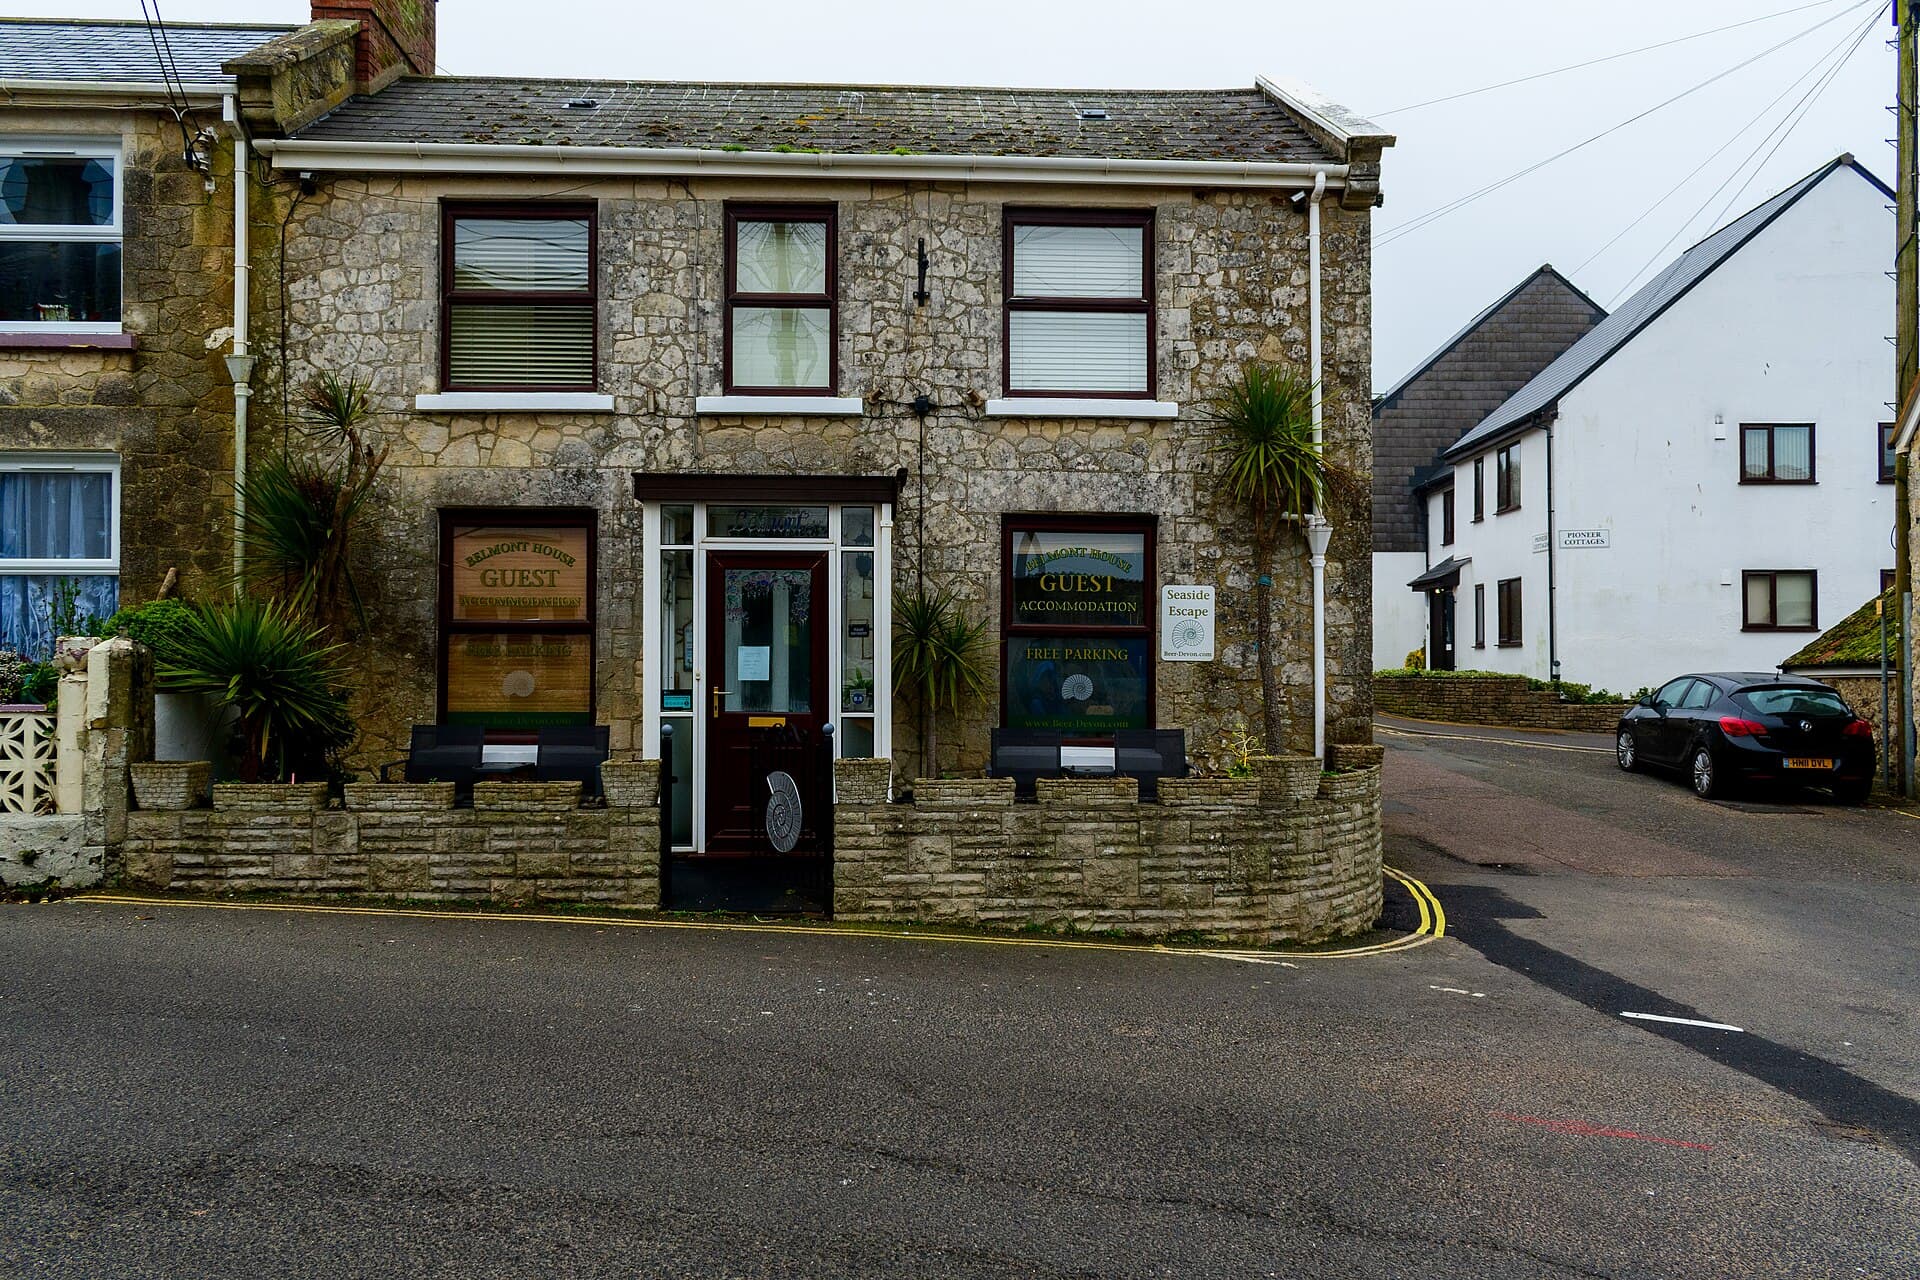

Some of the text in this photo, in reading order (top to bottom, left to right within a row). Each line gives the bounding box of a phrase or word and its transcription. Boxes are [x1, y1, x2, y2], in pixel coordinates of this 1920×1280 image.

[1567, 531, 1602, 539] PIONEER
[464, 541, 577, 568] BELMONT HOUSE
[1025, 547, 1133, 574] BELMONT HOUSE
[480, 568, 561, 588] GUEST
[1039, 573, 1118, 593] GUEST
[1167, 589, 1210, 600] Seaside
[1019, 600, 1137, 612] ACCOMMODATION
[1168, 605, 1209, 619] Escape
[1026, 648, 1129, 661] FREE PARKING
[1164, 650, 1212, 658] Beer-Devon.com
[1023, 719, 1129, 730] www.Beer-Devon.com
